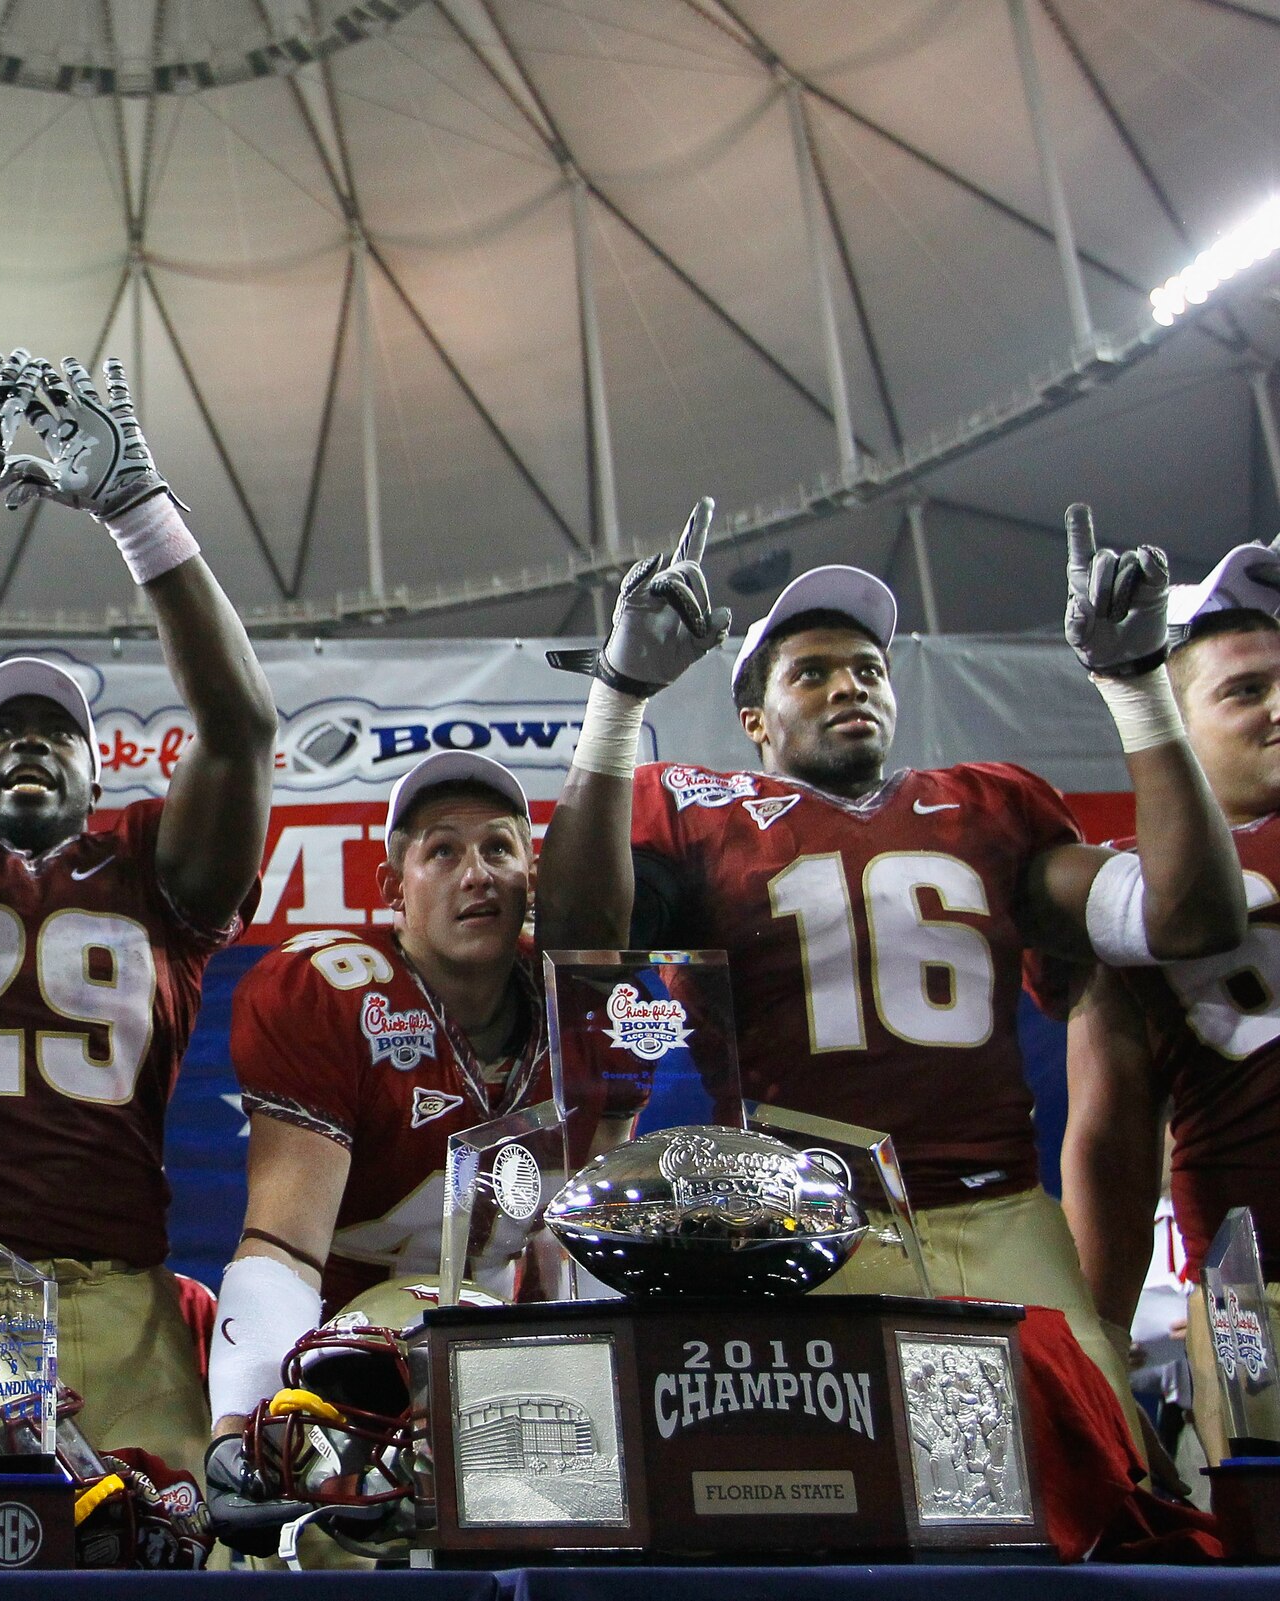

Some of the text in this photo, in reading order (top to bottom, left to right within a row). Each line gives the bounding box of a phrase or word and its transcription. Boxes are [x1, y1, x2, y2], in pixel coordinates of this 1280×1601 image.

[767, 850, 996, 1056] 16
[612, 994, 682, 1021] Chick-fil-A
[620, 1021, 676, 1033] BOWL
[375, 1034, 432, 1051] BOWL
[421, 1101, 439, 1110] ACC
[682, 1340, 834, 1368] 2010
[654, 1371, 875, 1440] CHAMPION
[706, 1484, 845, 1500] FLORIDA STATE
